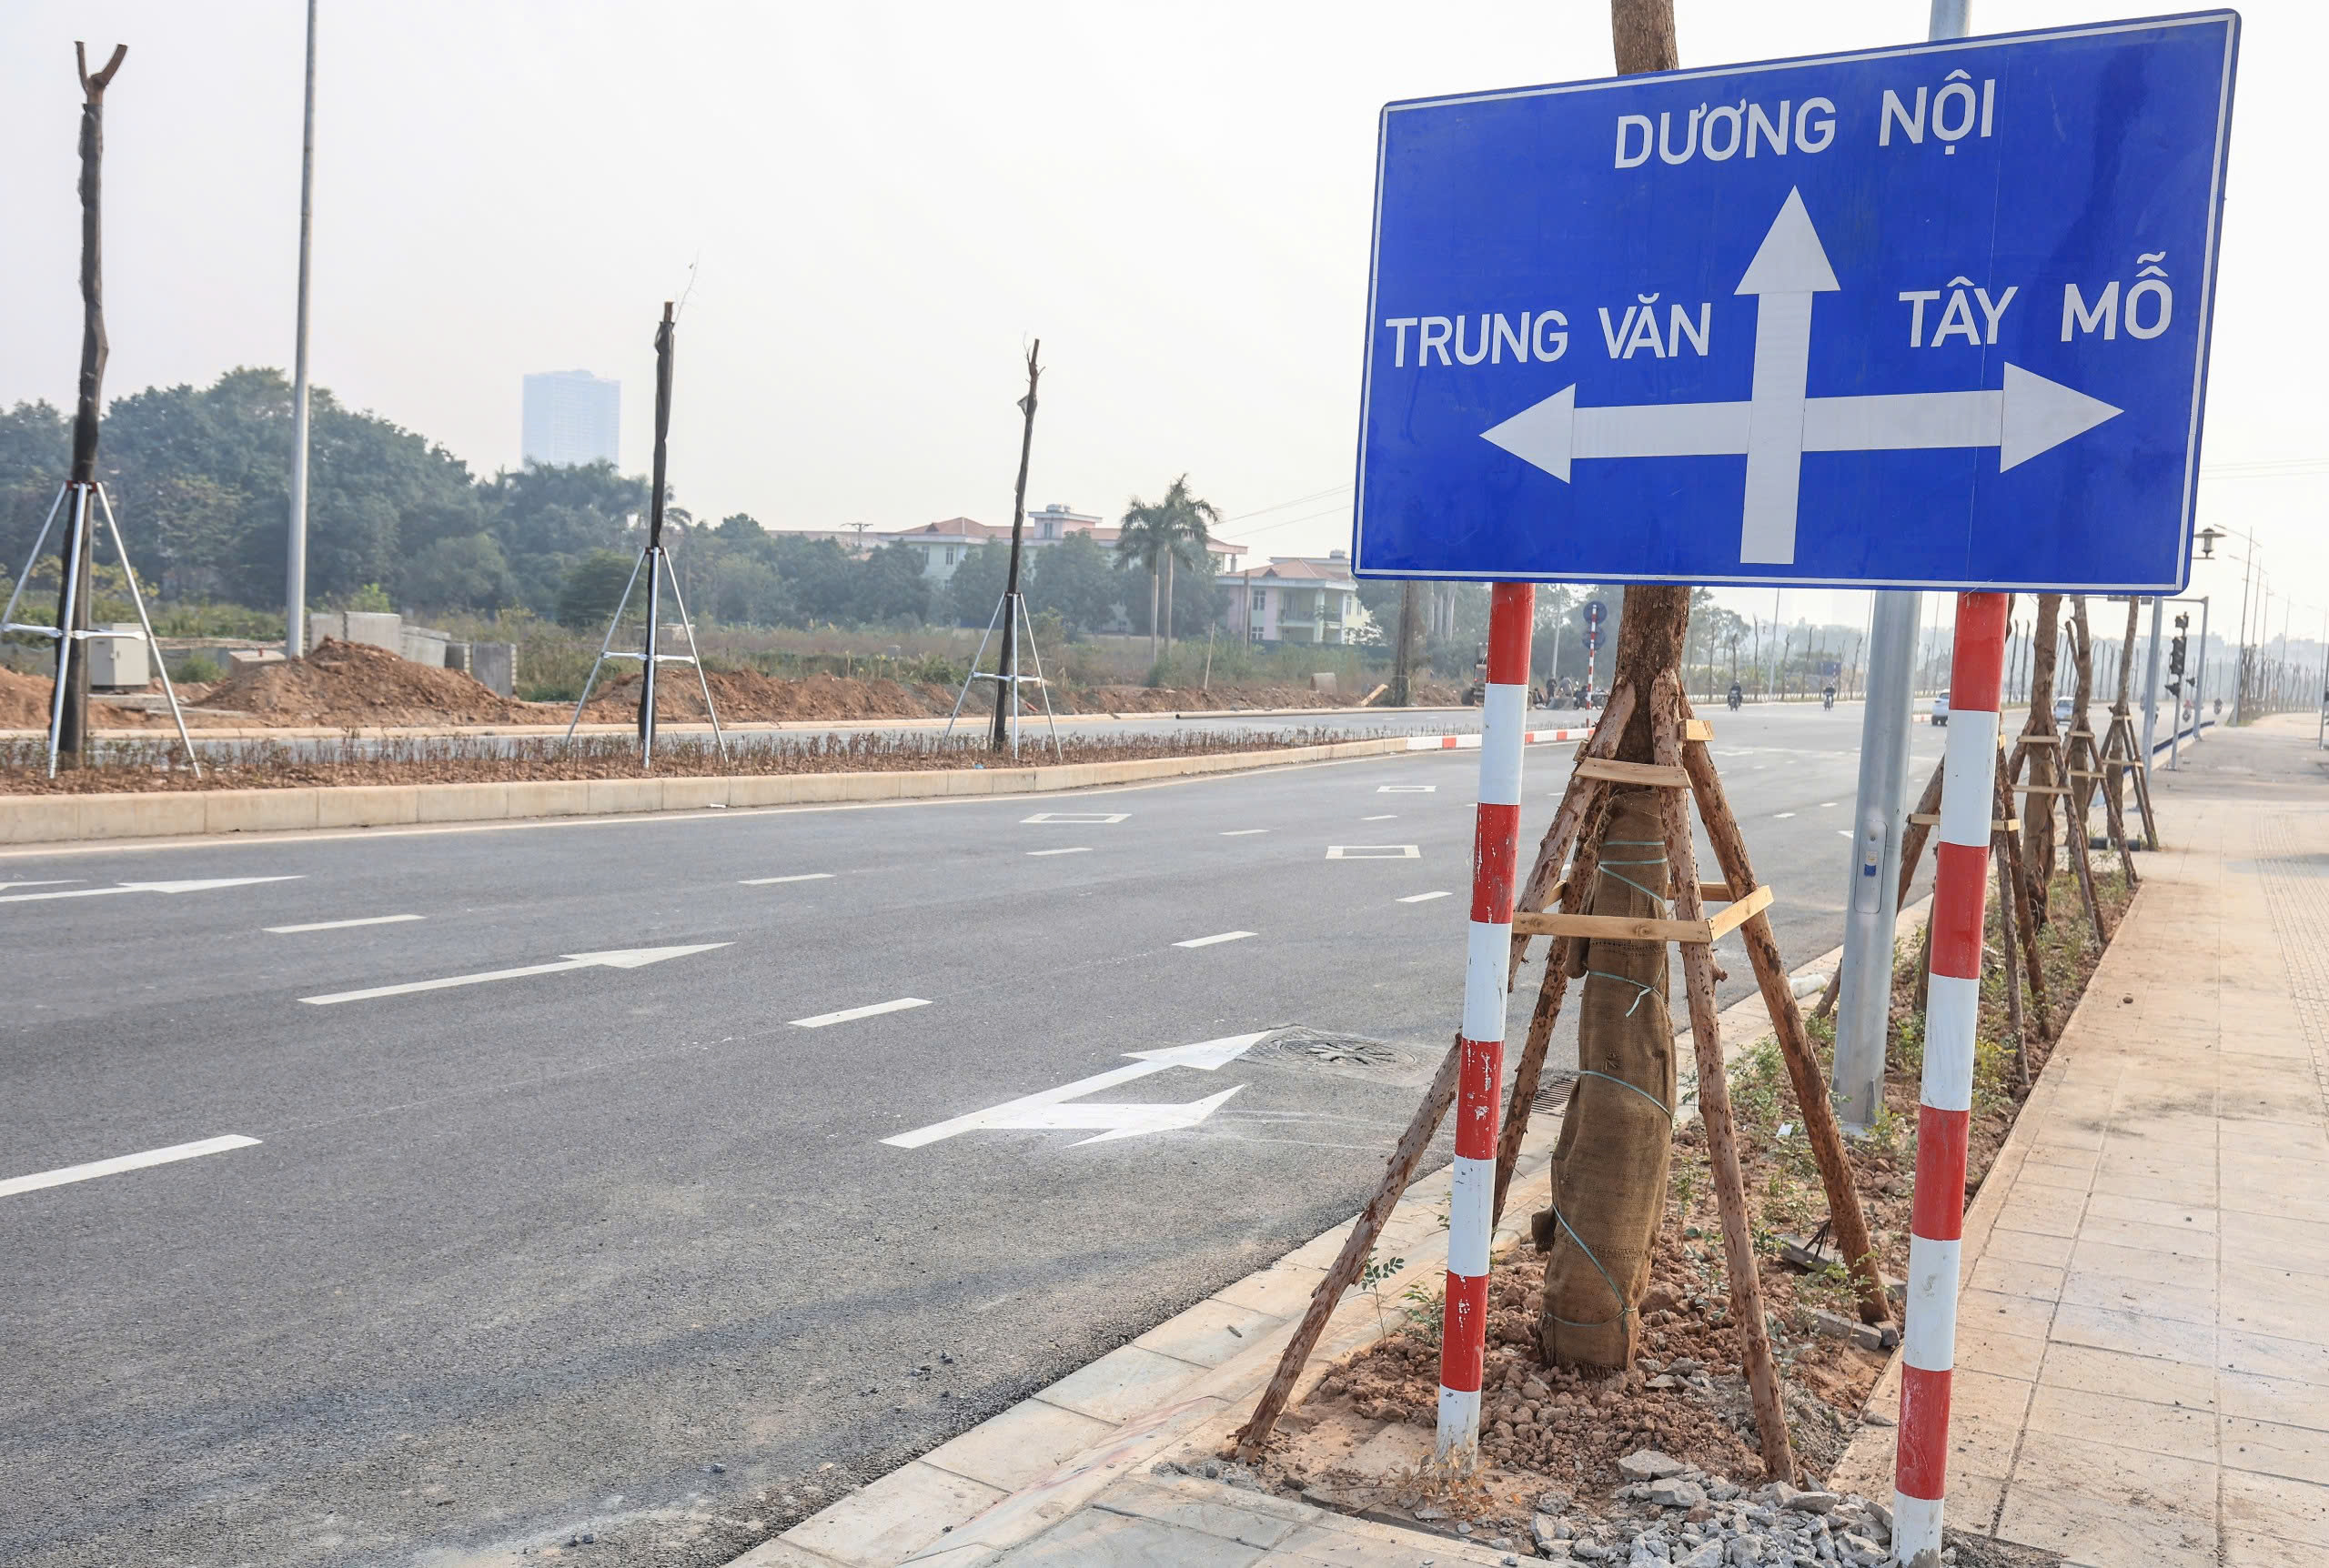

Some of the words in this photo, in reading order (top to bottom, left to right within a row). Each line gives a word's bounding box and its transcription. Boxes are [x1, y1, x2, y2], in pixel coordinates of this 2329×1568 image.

[1615, 97, 1835, 168] DƯƠNG
[1880, 69, 1996, 155] NỘI
[1386, 310, 1568, 367] TRUNG
[1598, 293, 1711, 359] VĂN
[1899, 276, 2018, 347] TÂY
[2061, 252, 2173, 342] MỖ
